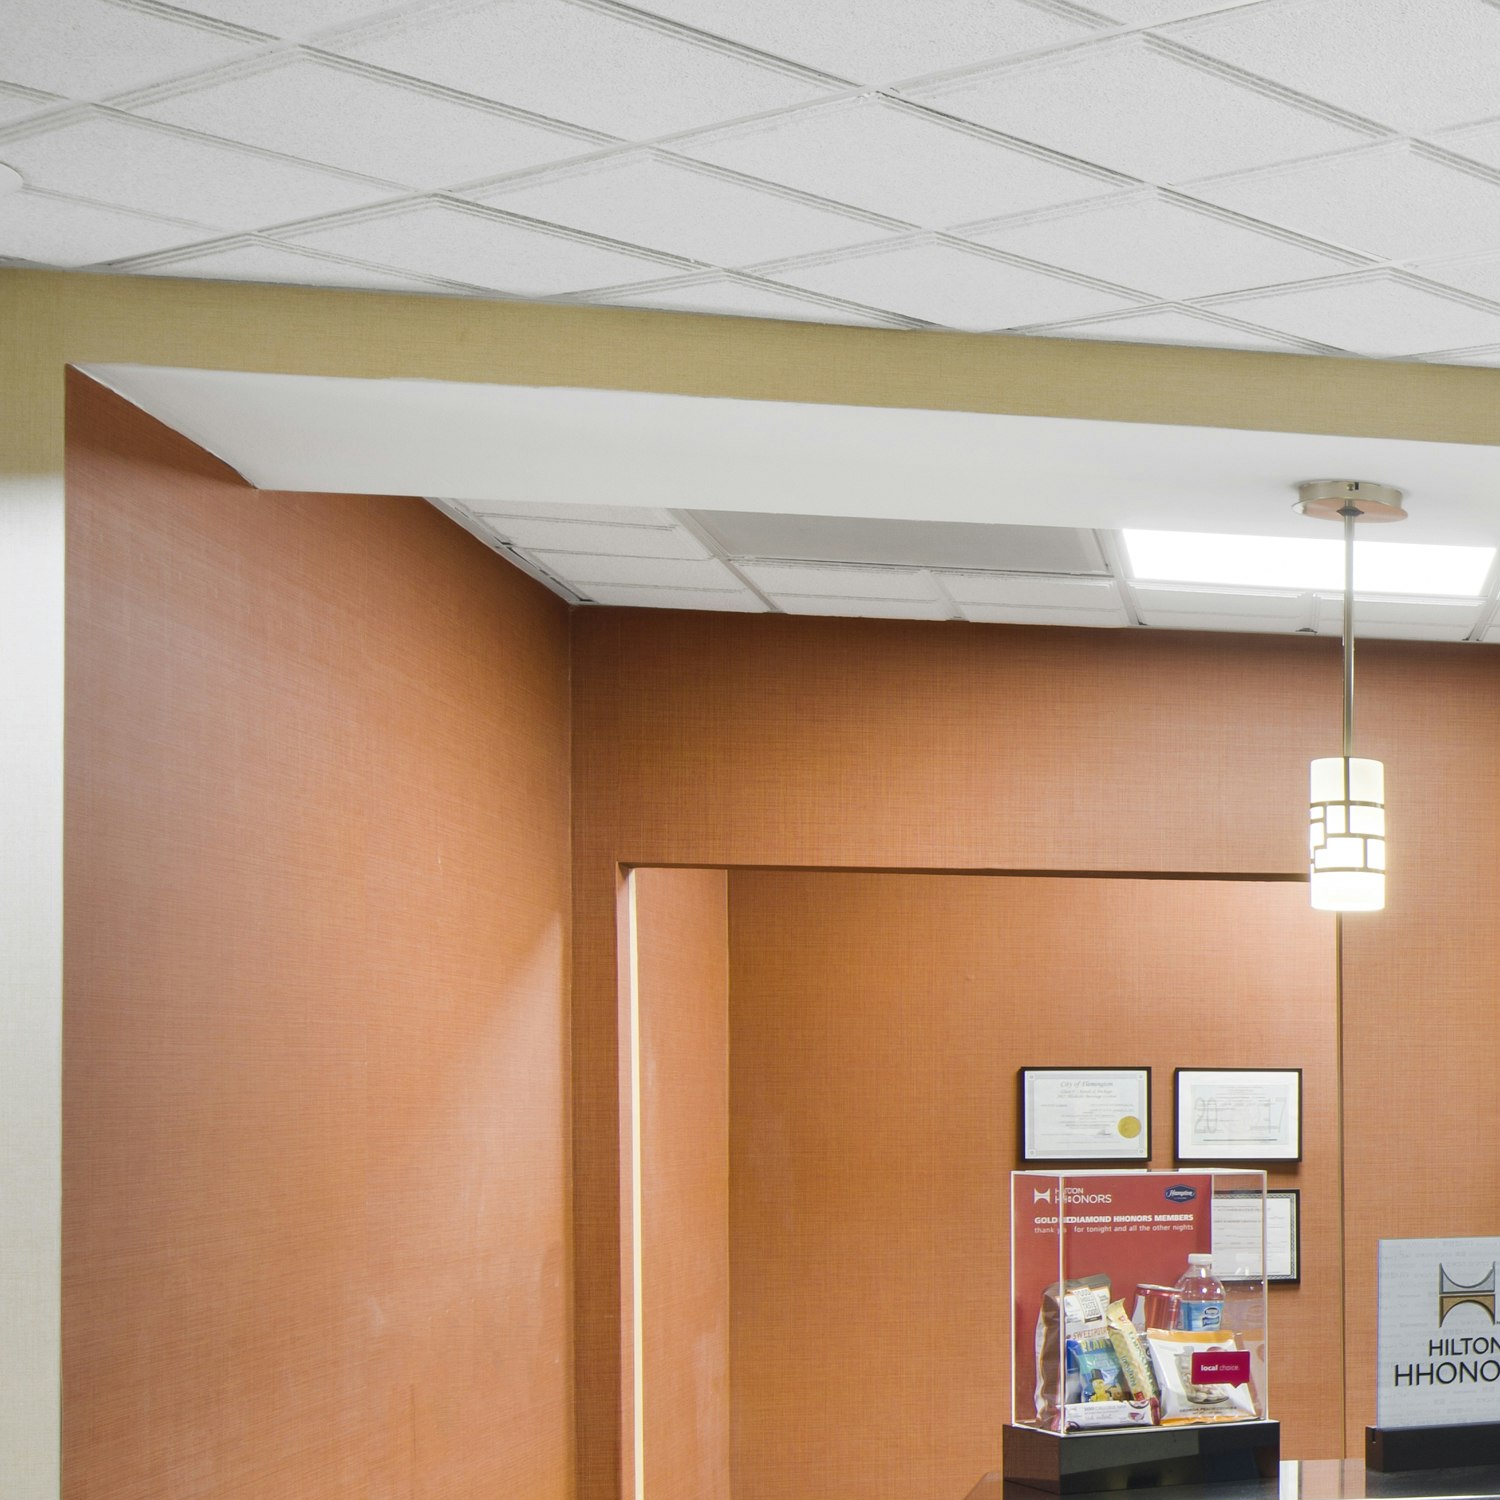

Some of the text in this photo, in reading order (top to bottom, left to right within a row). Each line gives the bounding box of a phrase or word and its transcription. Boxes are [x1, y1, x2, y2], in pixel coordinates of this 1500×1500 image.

[1034, 1216, 1058, 1224] GOLD
[1072, 1215, 1112, 1223] DIAMOND
[1113, 1214, 1153, 1223] HHONORS
[1154, 1214, 1194, 1222] MEMBERS
[1074, 1225, 1085, 1233] for
[1086, 1225, 1112, 1234] tonight
[1139, 1224, 1151, 1232] the
[1172, 1224, 1194, 1232] nights
[1200, 1364, 1218, 1372] local
